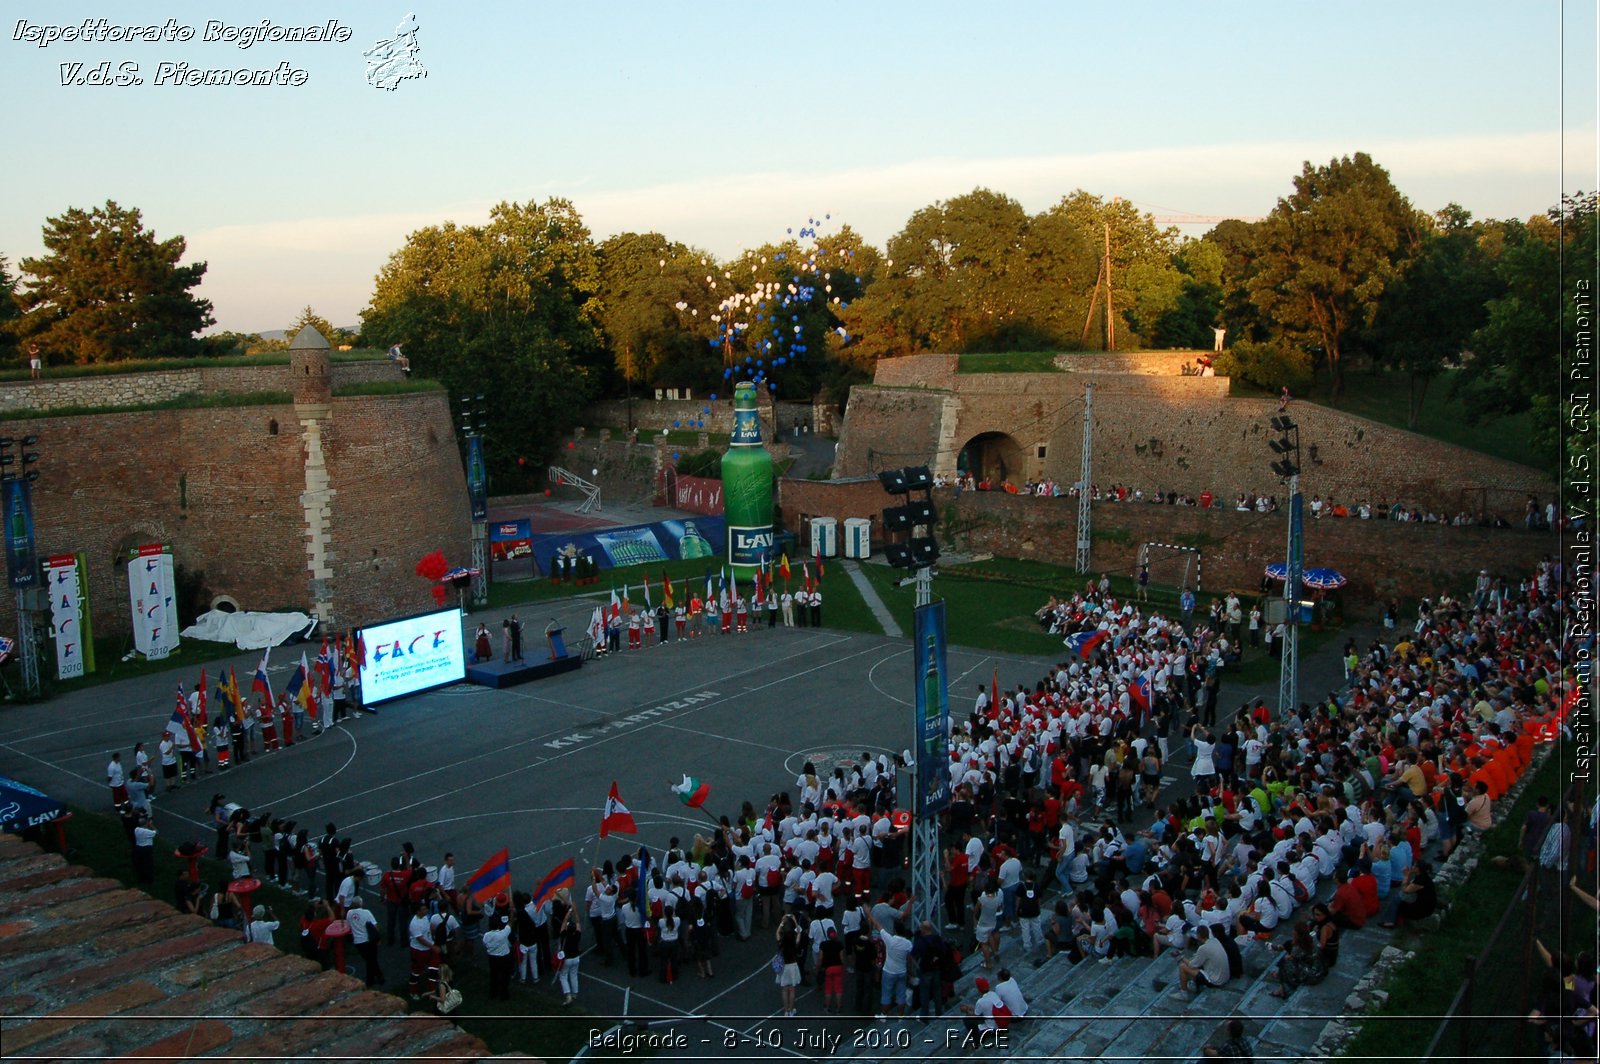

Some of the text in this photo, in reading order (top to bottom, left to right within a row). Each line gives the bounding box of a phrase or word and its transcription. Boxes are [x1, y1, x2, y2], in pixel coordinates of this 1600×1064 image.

[737, 532, 774, 549] LAV
[149, 646, 169, 657] 2010
[373, 629, 447, 662] FACE
[61, 662, 82, 675] 2010
[925, 717, 942, 731] LAV
[543, 732, 594, 749] KK
[925, 787, 944, 806] LAV
[27, 808, 61, 827] LAV
